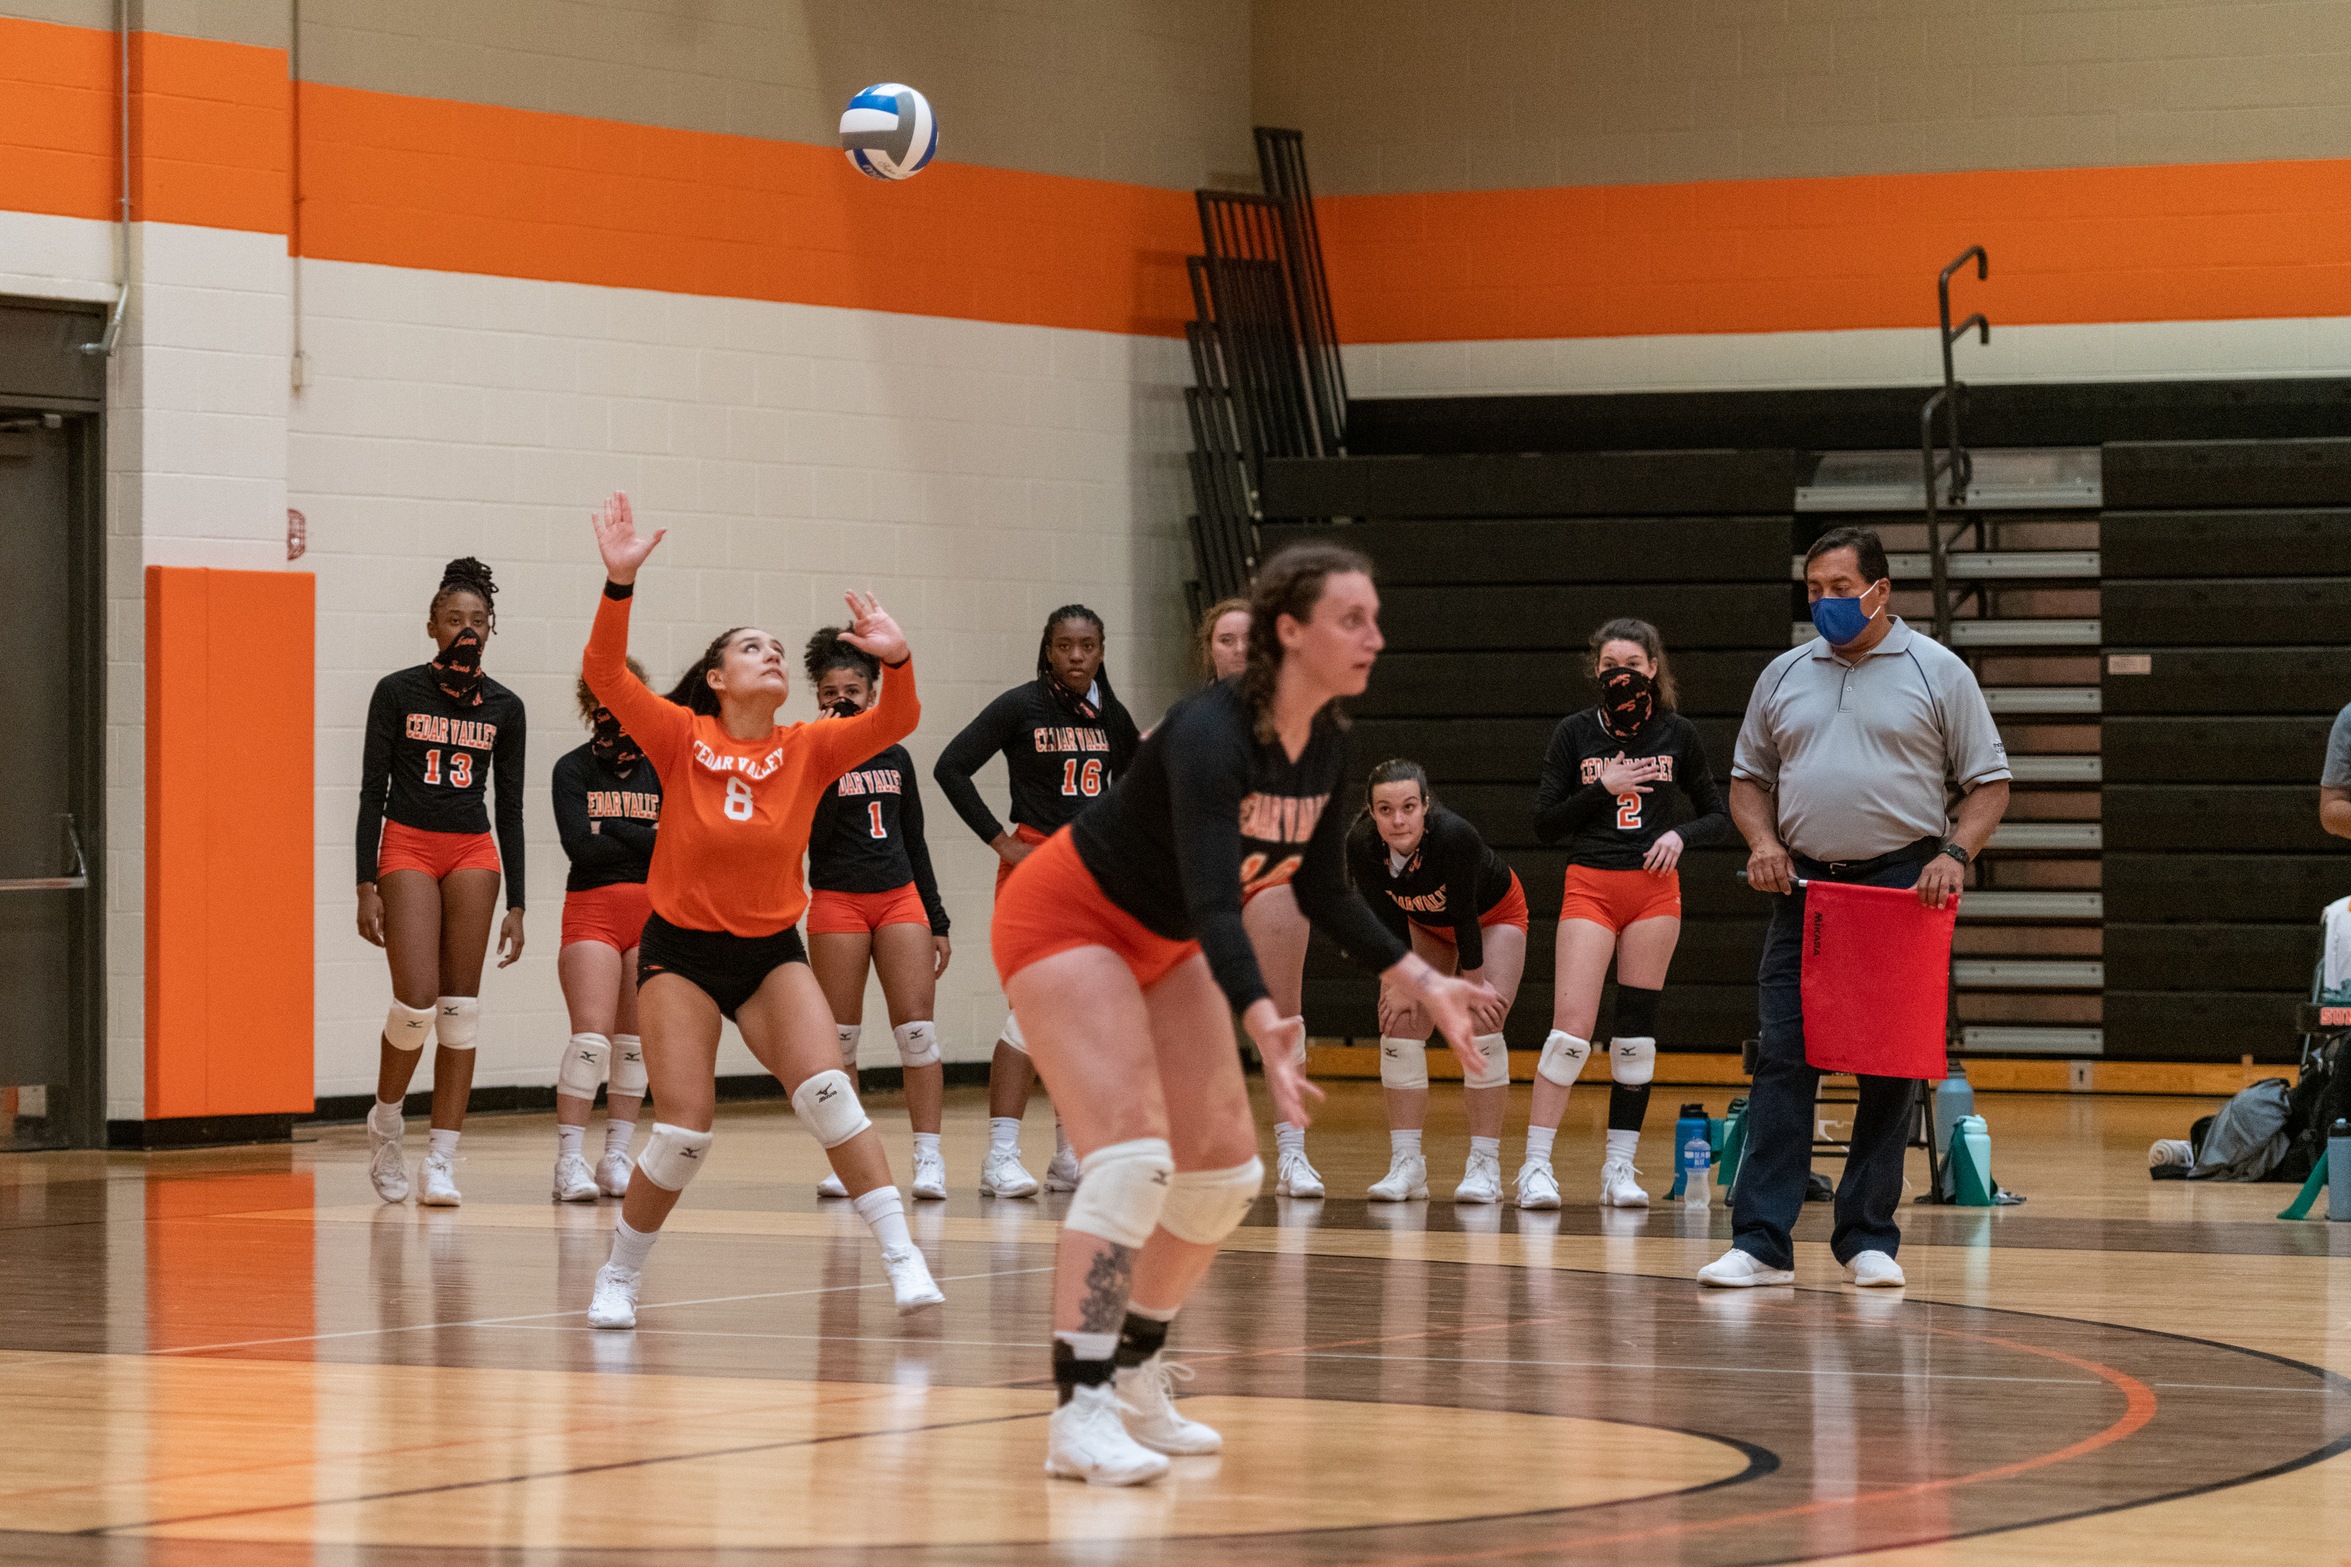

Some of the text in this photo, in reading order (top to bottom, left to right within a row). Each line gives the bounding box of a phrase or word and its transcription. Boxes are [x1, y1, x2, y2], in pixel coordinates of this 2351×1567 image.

[406, 713, 497, 750] CEDAR VALLE
[423, 749, 473, 788] 13
[693, 740, 734, 771] CEDAR
[1061, 758, 1103, 797] 16
[586, 791, 660, 820] EDAR VALLE
[724, 776, 754, 821] 8
[1616, 791, 1642, 829] 2
[868, 801, 887, 838] 1
